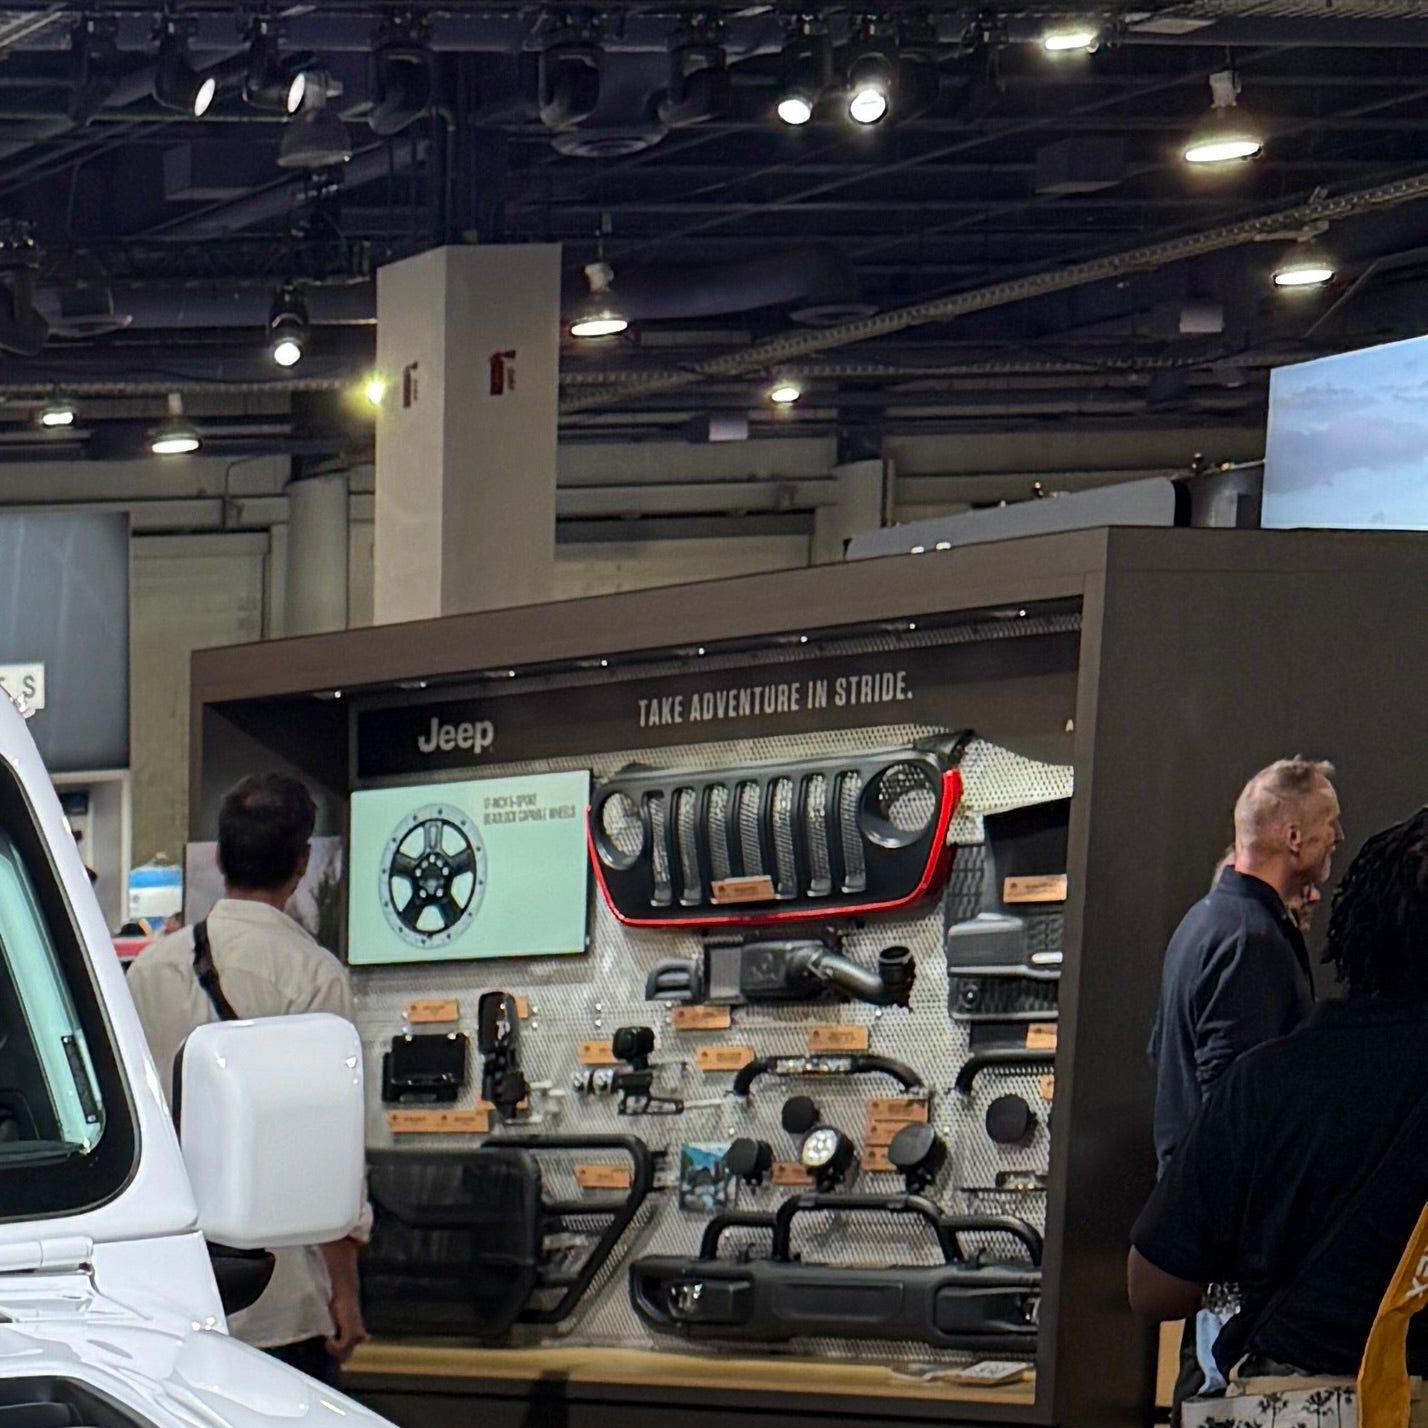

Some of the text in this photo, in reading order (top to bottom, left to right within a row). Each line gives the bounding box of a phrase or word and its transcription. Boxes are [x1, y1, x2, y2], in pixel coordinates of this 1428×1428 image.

[638, 670, 914, 728] TAKE ADVENTURE IN STRIDE.
[417, 716, 494, 753] Jeep
